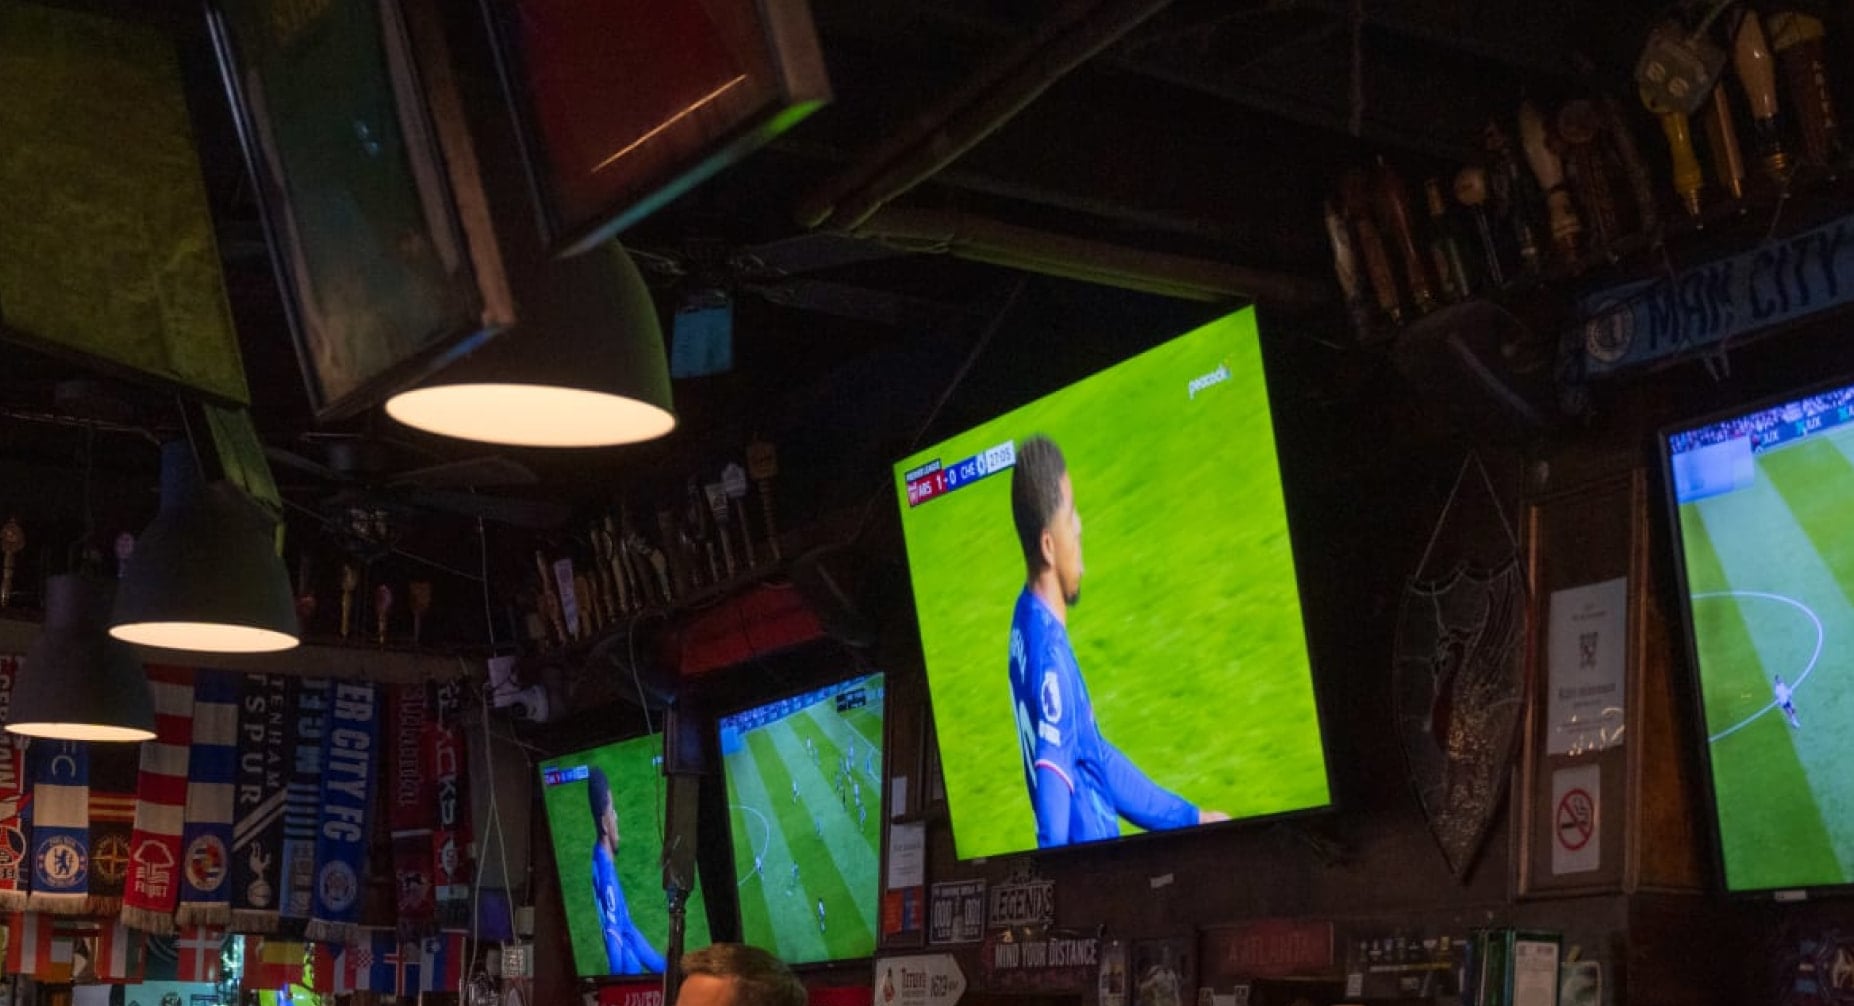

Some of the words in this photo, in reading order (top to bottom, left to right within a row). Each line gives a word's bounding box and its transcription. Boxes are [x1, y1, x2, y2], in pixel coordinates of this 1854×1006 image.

[1752, 224, 1844, 319] CITY
[327, 727, 371, 799] CITY
[322, 804, 365, 844] FC
[1048, 938, 1098, 967] DISTANCE
